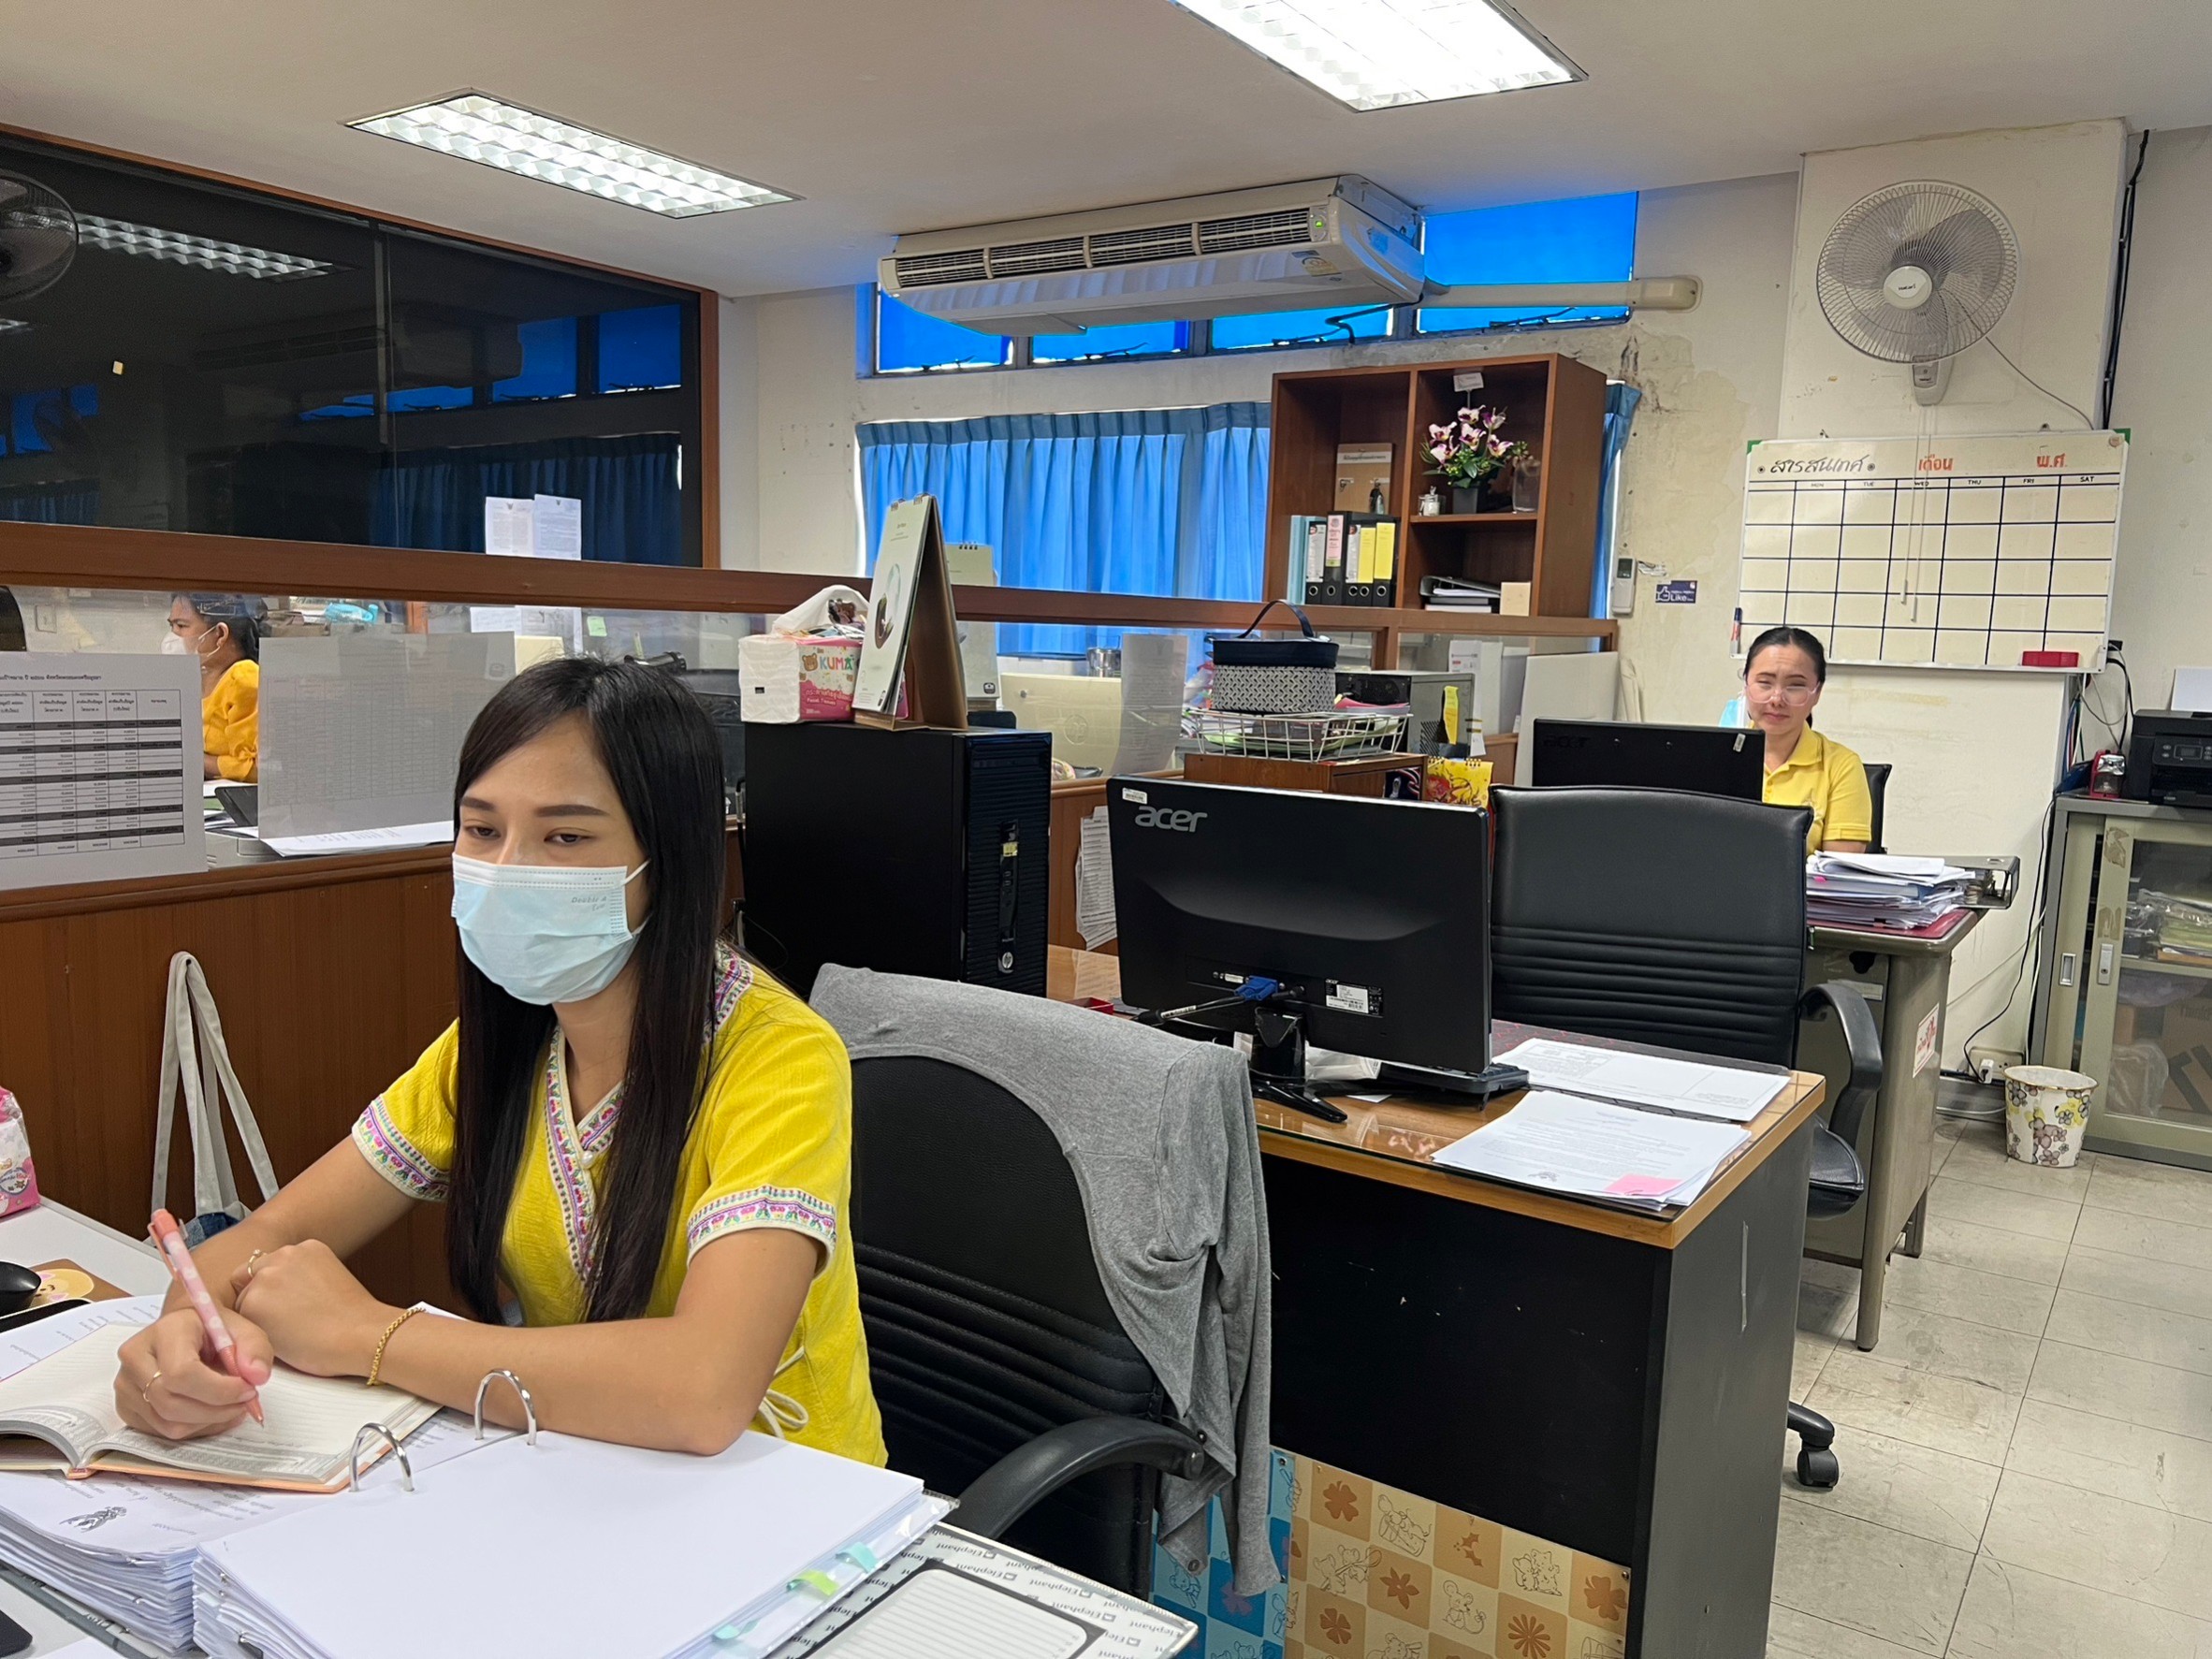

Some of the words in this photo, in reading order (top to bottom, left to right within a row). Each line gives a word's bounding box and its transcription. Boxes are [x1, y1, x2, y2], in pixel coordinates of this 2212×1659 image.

[1918, 454, 1954, 472] เดือน
[820, 656, 853, 671] KUMA
[1134, 806, 1208, 833] acer
[936, 1543, 982, 1557] Elephant
[956, 1564, 1003, 1579] Elephant
[1029, 1579, 1079, 1596] Elephant
[1051, 1601, 1101, 1620] Elephant
